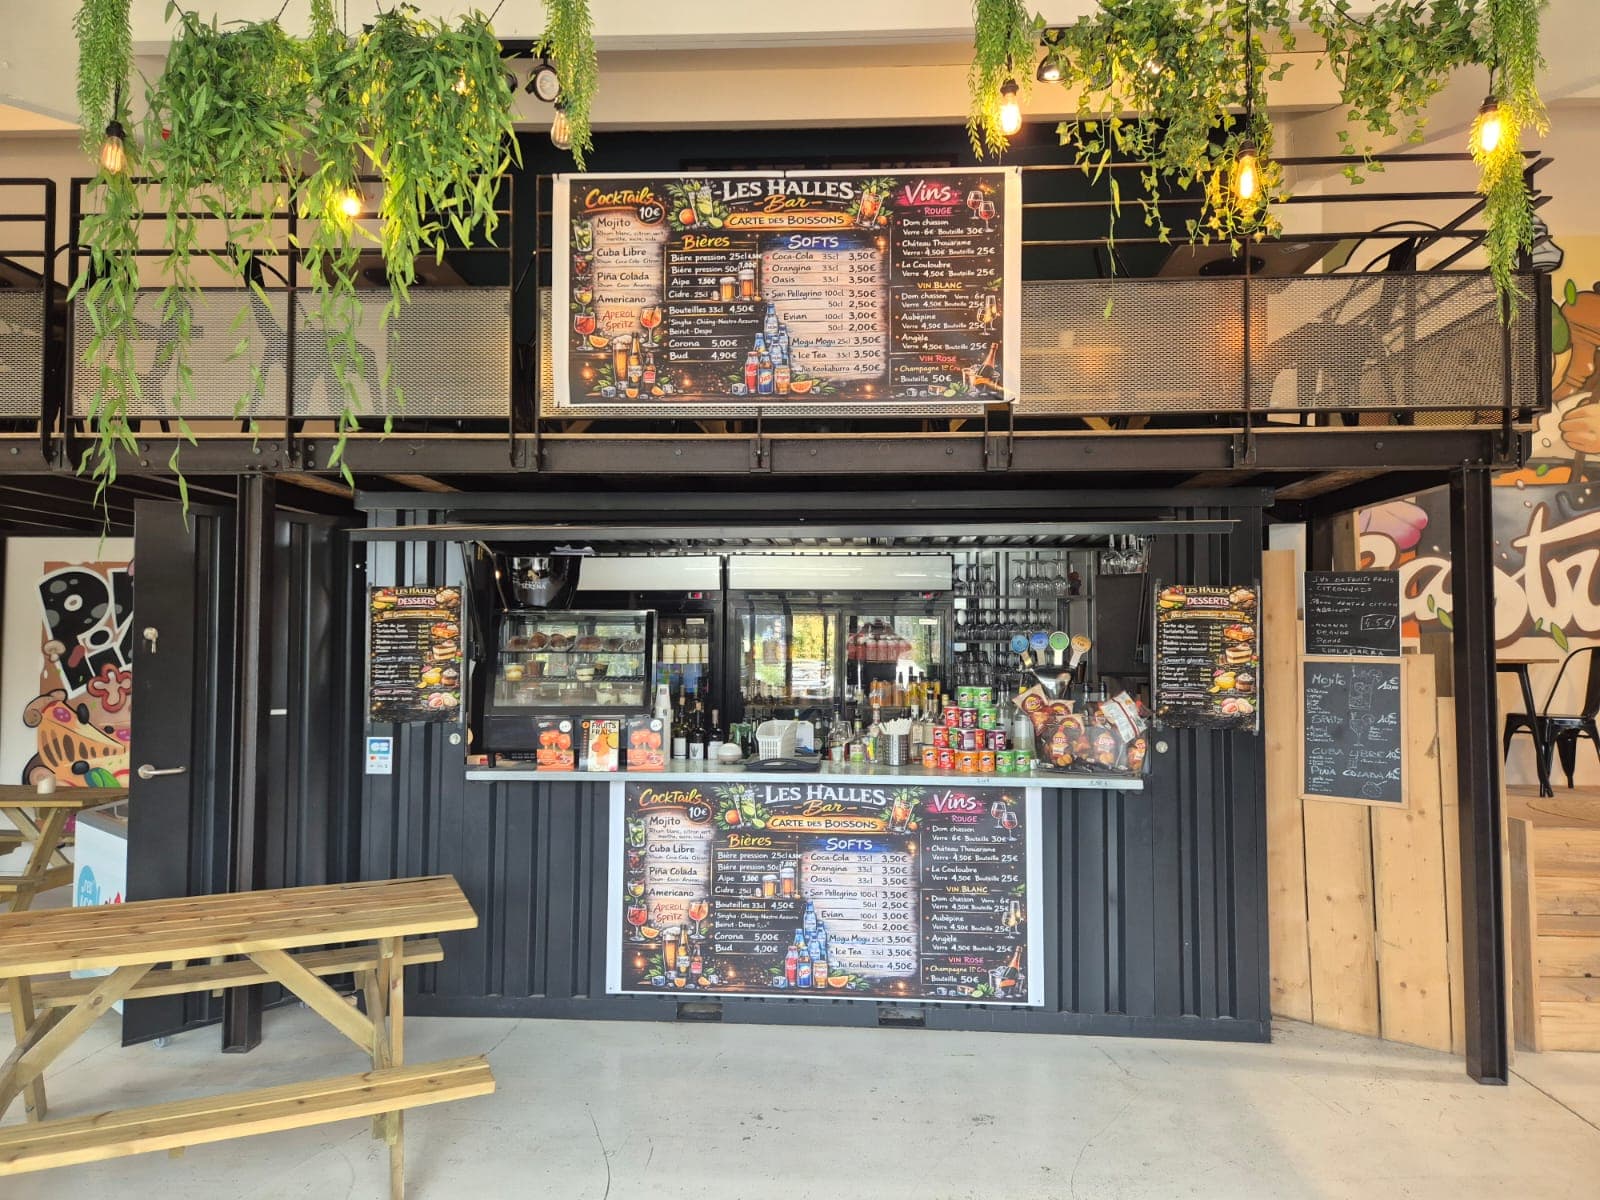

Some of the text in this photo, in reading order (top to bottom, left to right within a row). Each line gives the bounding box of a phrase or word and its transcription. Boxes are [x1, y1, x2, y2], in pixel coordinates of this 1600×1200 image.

[722, 179, 854, 200] LES HALLES
[904, 180, 952, 203] Vins
[764, 195, 808, 212] Bar
[639, 207, 660, 219] 10€
[924, 206, 952, 215] ROUGE
[597, 218, 630, 230] Mojito
[730, 218, 764, 226] CARTE
[787, 215, 844, 225] BOISSONS
[967, 227, 984, 236] 30€
[682, 234, 730, 249] Bières
[788, 234, 839, 250] SOFTS
[596, 248, 647, 257] Cuba Libre
[976, 246, 996, 256] 25€
[671, 254, 692, 262] Bière
[695, 254, 726, 263] pression
[772, 252, 876, 262] Coca-Cola 3,50€
[694, 266, 723, 274] pression
[772, 264, 876, 274] Orangina 3,50€
[977, 268, 996, 277] 25€
[598, 272, 650, 281] Piña Colada
[772, 276, 876, 284] Oasis 3,50€
[934, 282, 962, 290] BLANC
[848, 290, 876, 298] 3,50€
[597, 295, 646, 304] Americano
[848, 300, 877, 309] 2,50€
[669, 305, 706, 314] Bouteilles
[602, 311, 635, 322] APEROL
[784, 312, 877, 321] Evian 3,00€
[848, 323, 878, 332] 2,00€
[669, 339, 738, 348] Corona 5,00€
[853, 336, 881, 345] 3,50€
[670, 352, 738, 360] Bud 4,90€
[853, 350, 881, 360] 3,50€
[853, 364, 881, 373] 4,50€
[932, 374, 952, 384] 50€
[398, 596, 436, 606] DESSERTS
[1187, 596, 1230, 606] DESSERTS
[1312, 672, 1346, 688] Mojito
[764, 786, 886, 805] LES HALLES
[934, 790, 976, 812] Vins
[688, 806, 708, 818] 10€
[803, 800, 846, 816] Bar
[648, 816, 680, 828] Mojito
[772, 819, 804, 828] CARTE
[825, 820, 878, 829] BOISSONS
[952, 815, 978, 824] ROUGE
[728, 834, 772, 848] Bières
[826, 838, 873, 852] SOFTS
[648, 844, 695, 854] Cuba Libre
[810, 854, 908, 864] Coca-Cola 3,50€
[670, 867, 698, 876] Colada
[810, 865, 908, 875] Orangina 3,50€
[882, 877, 908, 886] 3,50€
[648, 888, 694, 897] Americano
[882, 891, 908, 900] 3,50€
[714, 900, 750, 910] Bouteilles
[882, 901, 909, 910] 2,50€
[882, 912, 909, 921] 3,00€
[882, 922, 909, 932] 2,00€
[714, 932, 744, 942] Corona
[887, 936, 912, 945] 3,50€
[715, 944, 733, 952] Bud
[887, 948, 913, 958] 3,50€
[887, 962, 913, 971] 4,50€
[960, 976, 979, 984] 50€
